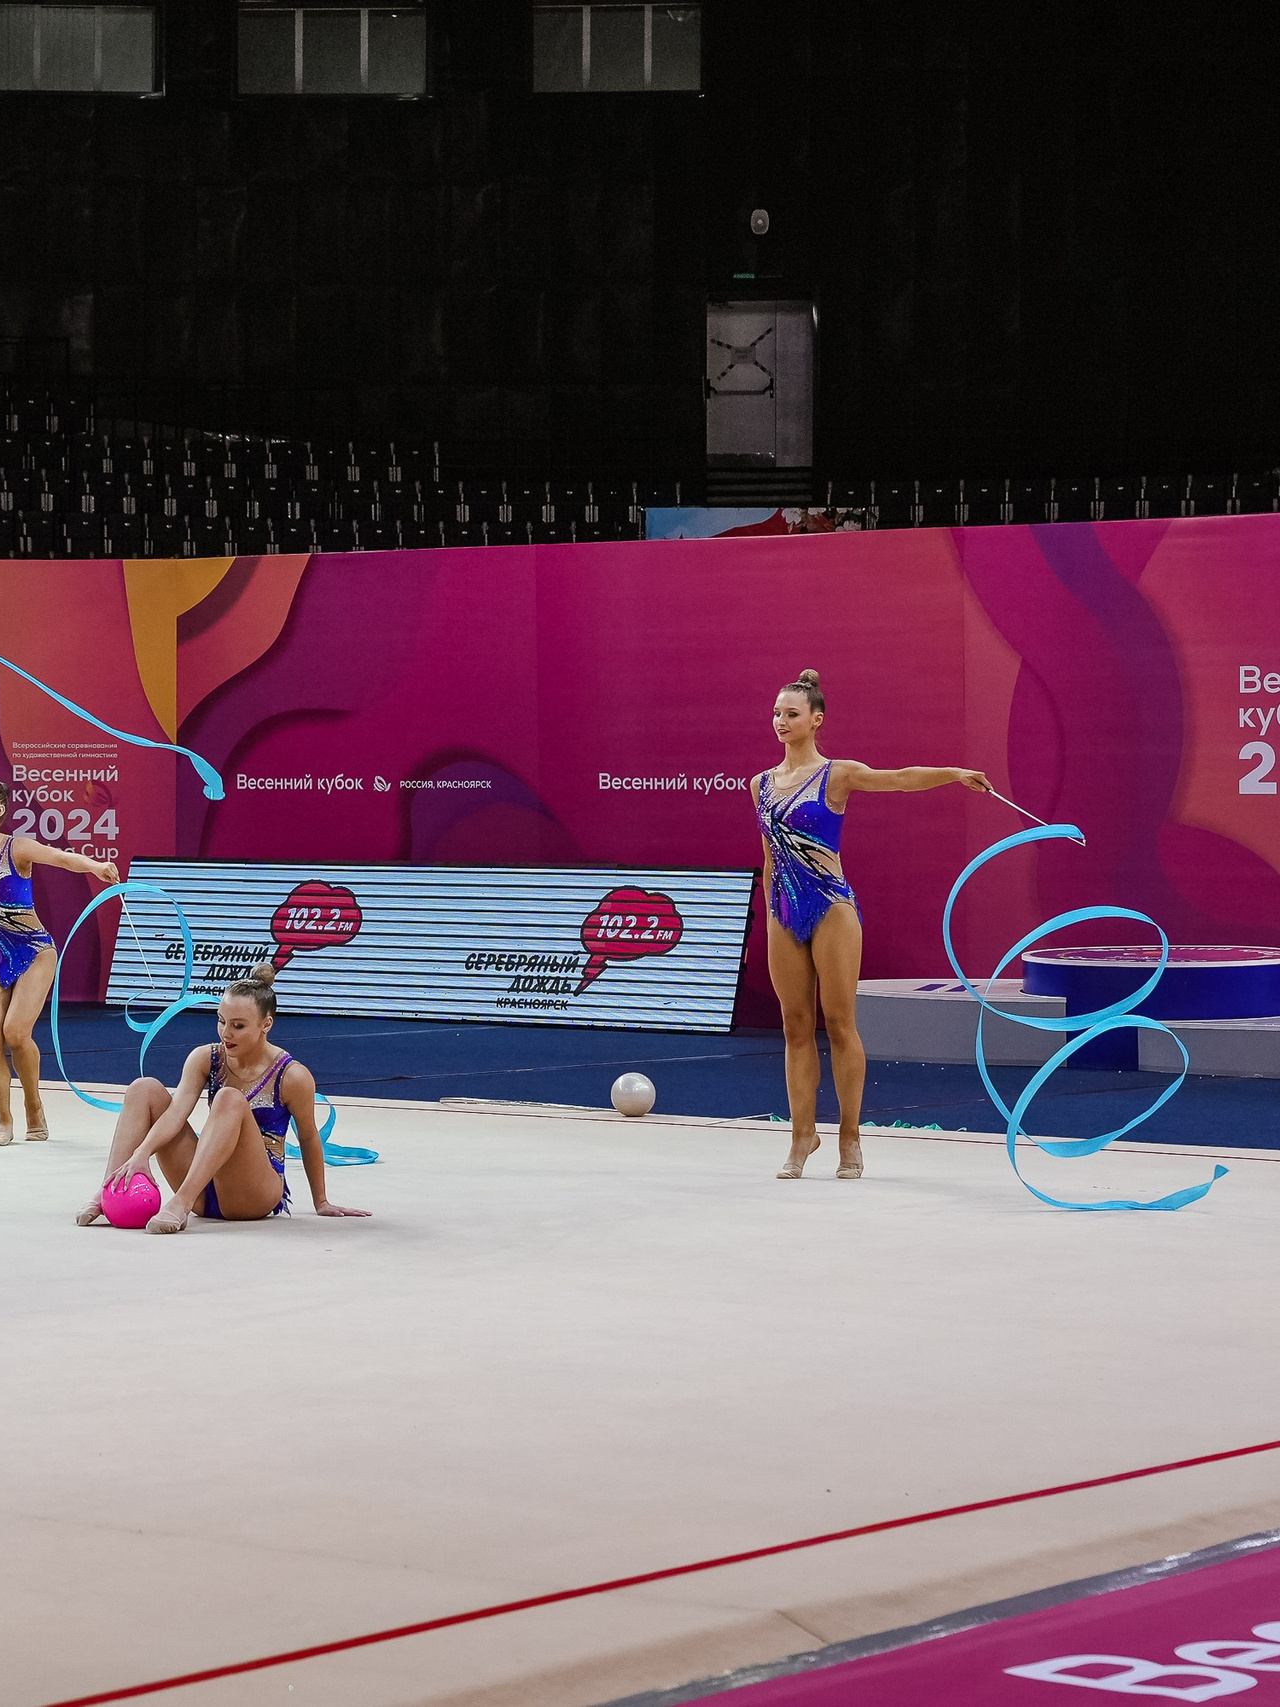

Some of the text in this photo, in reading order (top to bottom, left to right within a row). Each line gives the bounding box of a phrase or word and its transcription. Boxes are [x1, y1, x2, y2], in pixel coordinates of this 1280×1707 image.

[12, 741, 66, 749] Всероссийские
[22, 751, 78, 759] художественной
[12, 764, 119, 782] Весенний
[236, 773, 364, 794] Весенний кубок
[399, 780, 492, 790] РОССИЯ, КРАСНОЯРСК
[598, 772, 747, 795] Весенний кубок
[12, 785, 75, 807] кубок
[12, 808, 119, 841] 2024
[81, 843, 119, 862] Cup
[285, 907, 354, 932] 102.2 FM
[597, 914, 674, 940] 102.2 FM
[464, 951, 580, 974] СЕРЕБРЯНЫЙ
[508, 974, 572, 994] ДОЖДЬ
[496, 997, 570, 1011] КРАСНОЯРСК
